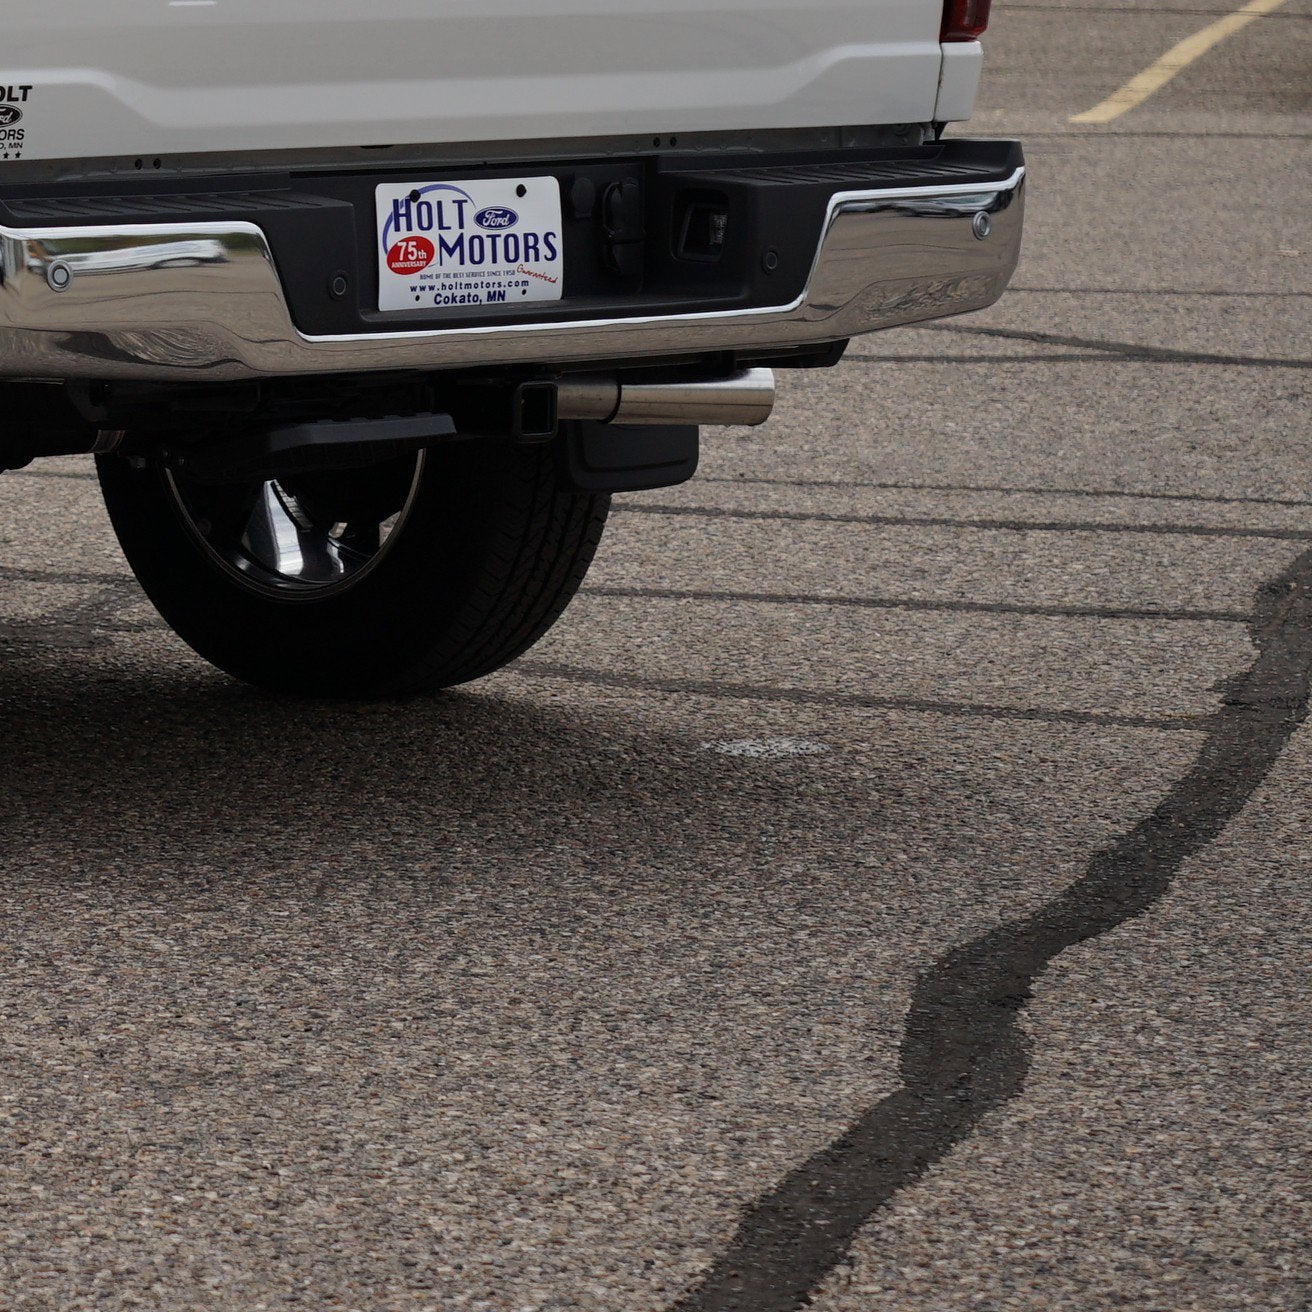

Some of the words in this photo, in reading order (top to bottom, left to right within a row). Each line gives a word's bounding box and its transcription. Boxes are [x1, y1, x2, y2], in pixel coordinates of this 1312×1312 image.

[392, 198, 468, 233] HOLT
[397, 240, 427, 262] 75th
[438, 231, 558, 267] MOTORS
[391, 260, 427, 269] ANNIVERSARY
[516, 263, 558, 284] Guaranteed
[410, 279, 529, 293] www.holtmotors.com
[434, 291, 483, 305] Cokato,
[487, 290, 506, 302] MN
